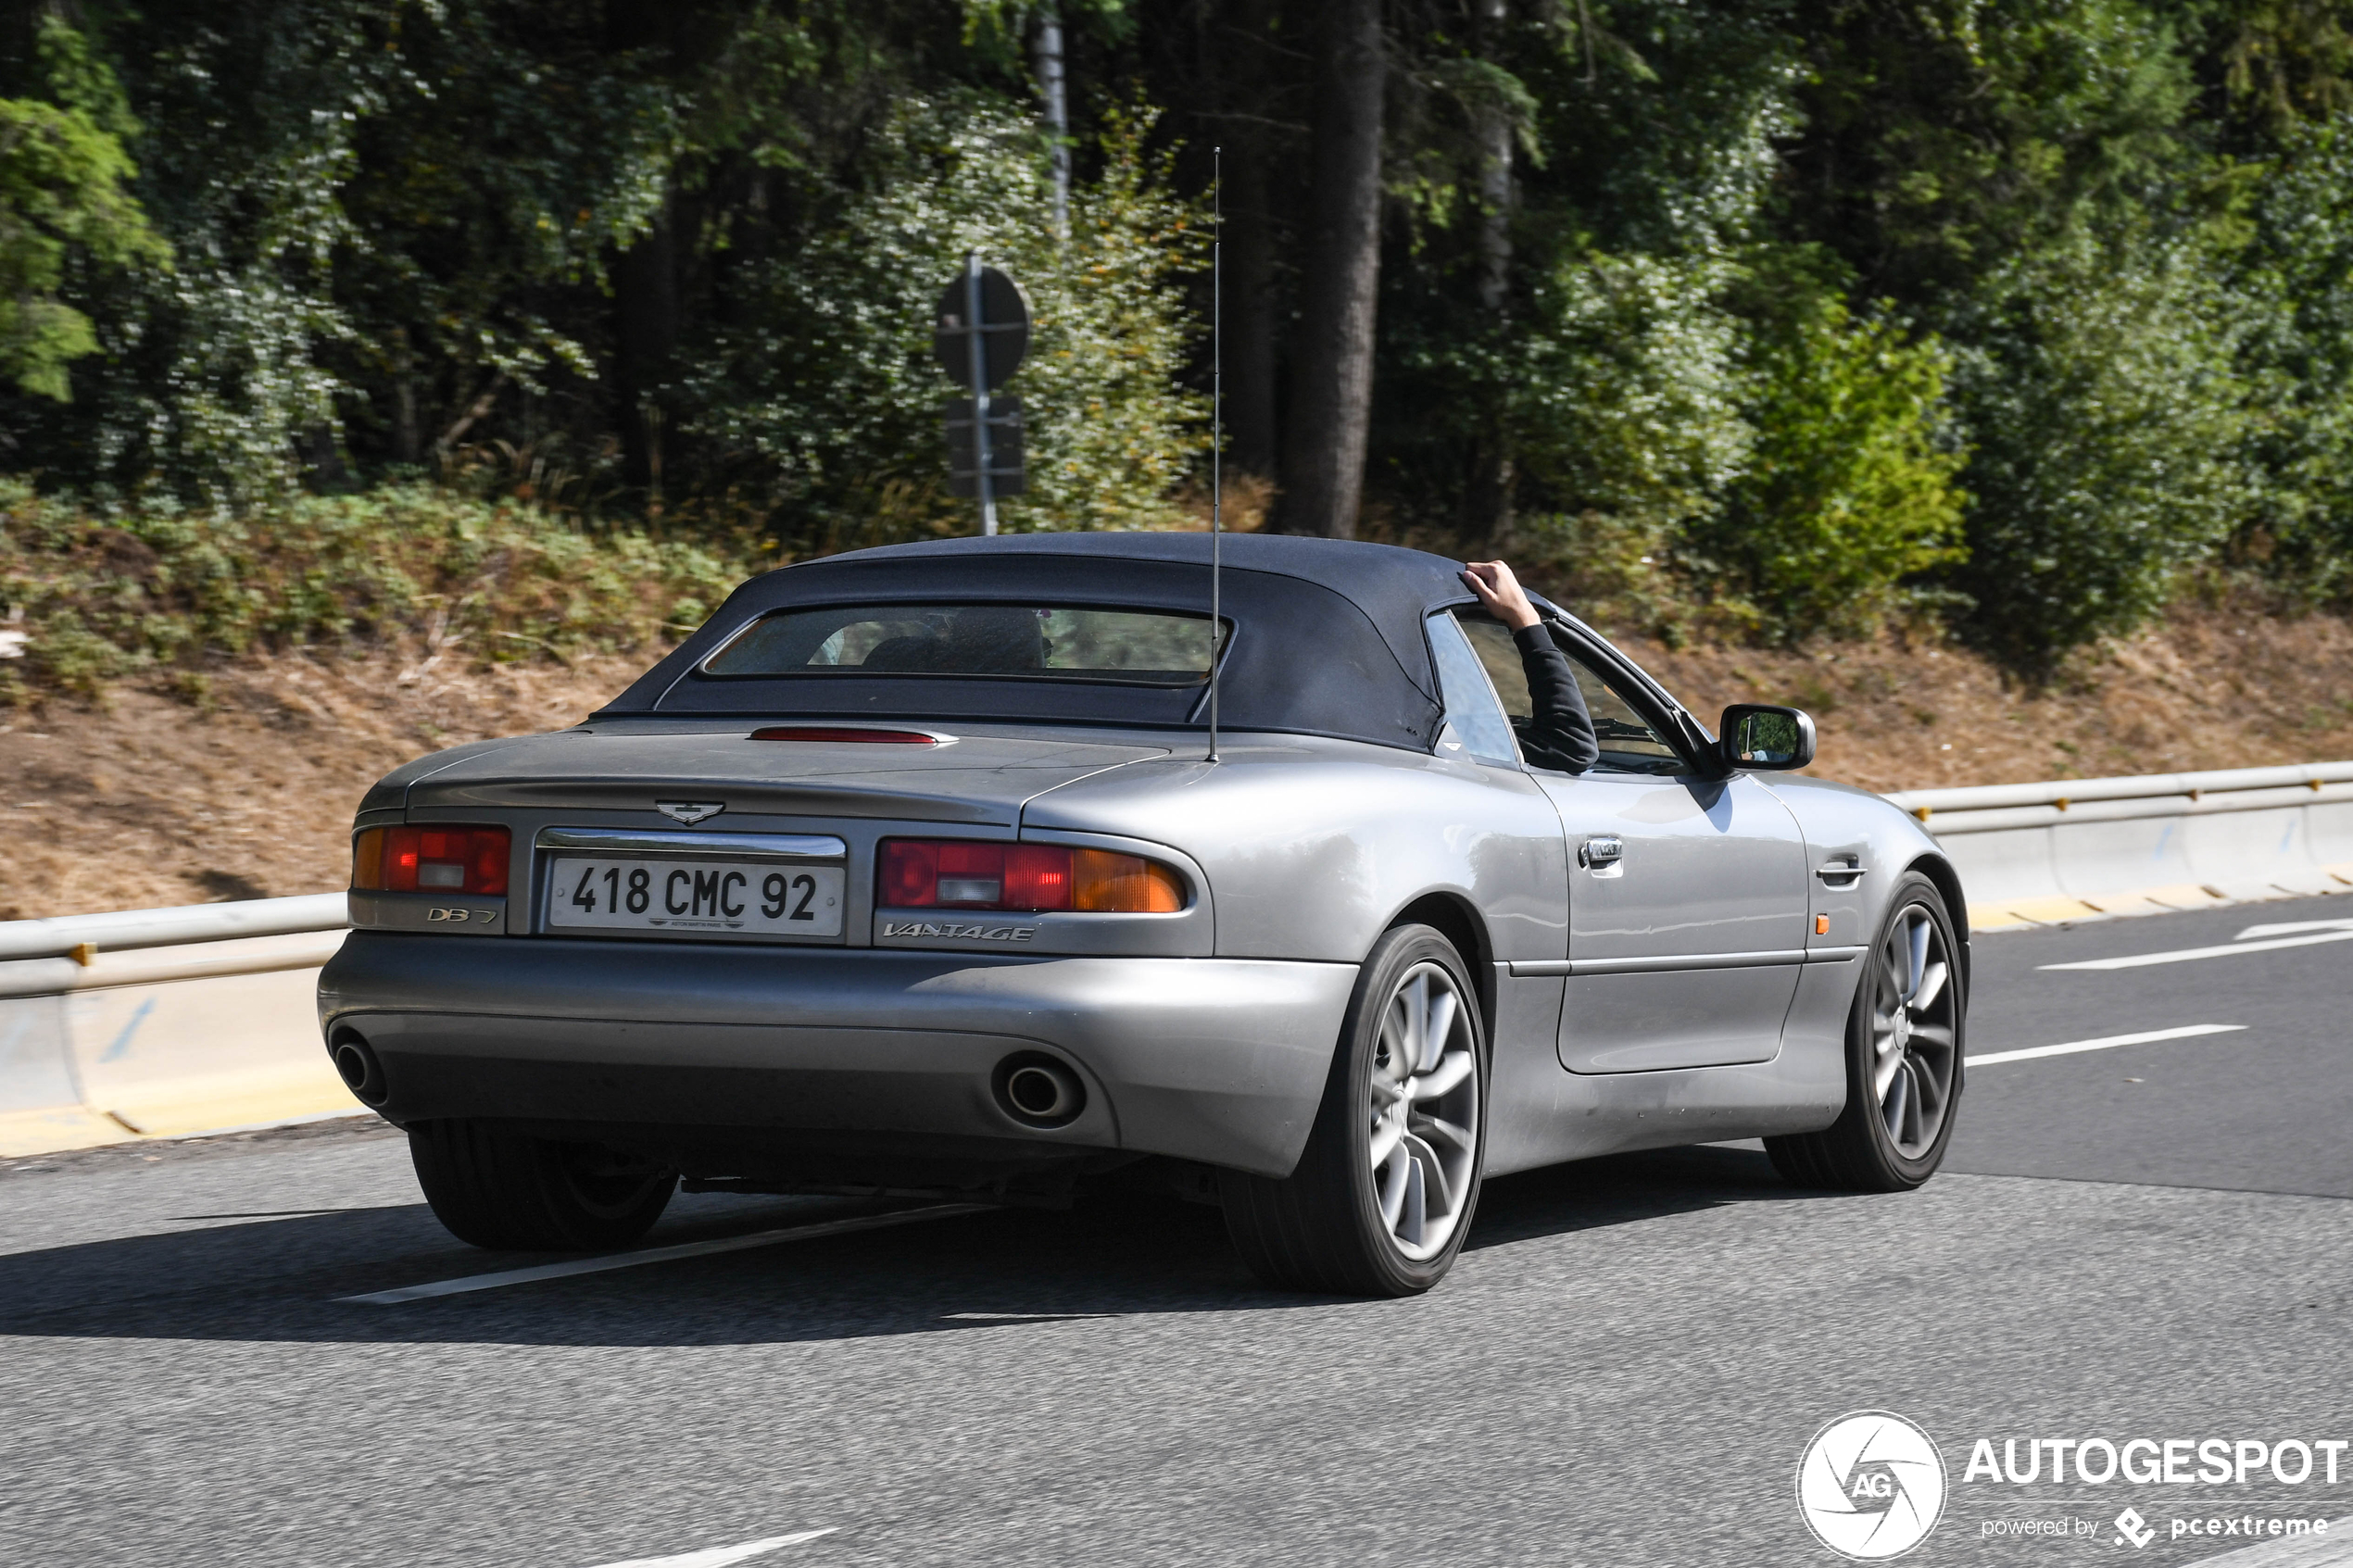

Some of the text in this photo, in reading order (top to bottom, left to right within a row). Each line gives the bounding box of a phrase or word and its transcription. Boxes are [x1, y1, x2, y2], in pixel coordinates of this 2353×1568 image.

[573, 867, 816, 920] 418 CMC 92
[883, 923, 1036, 942] VANTAGE
